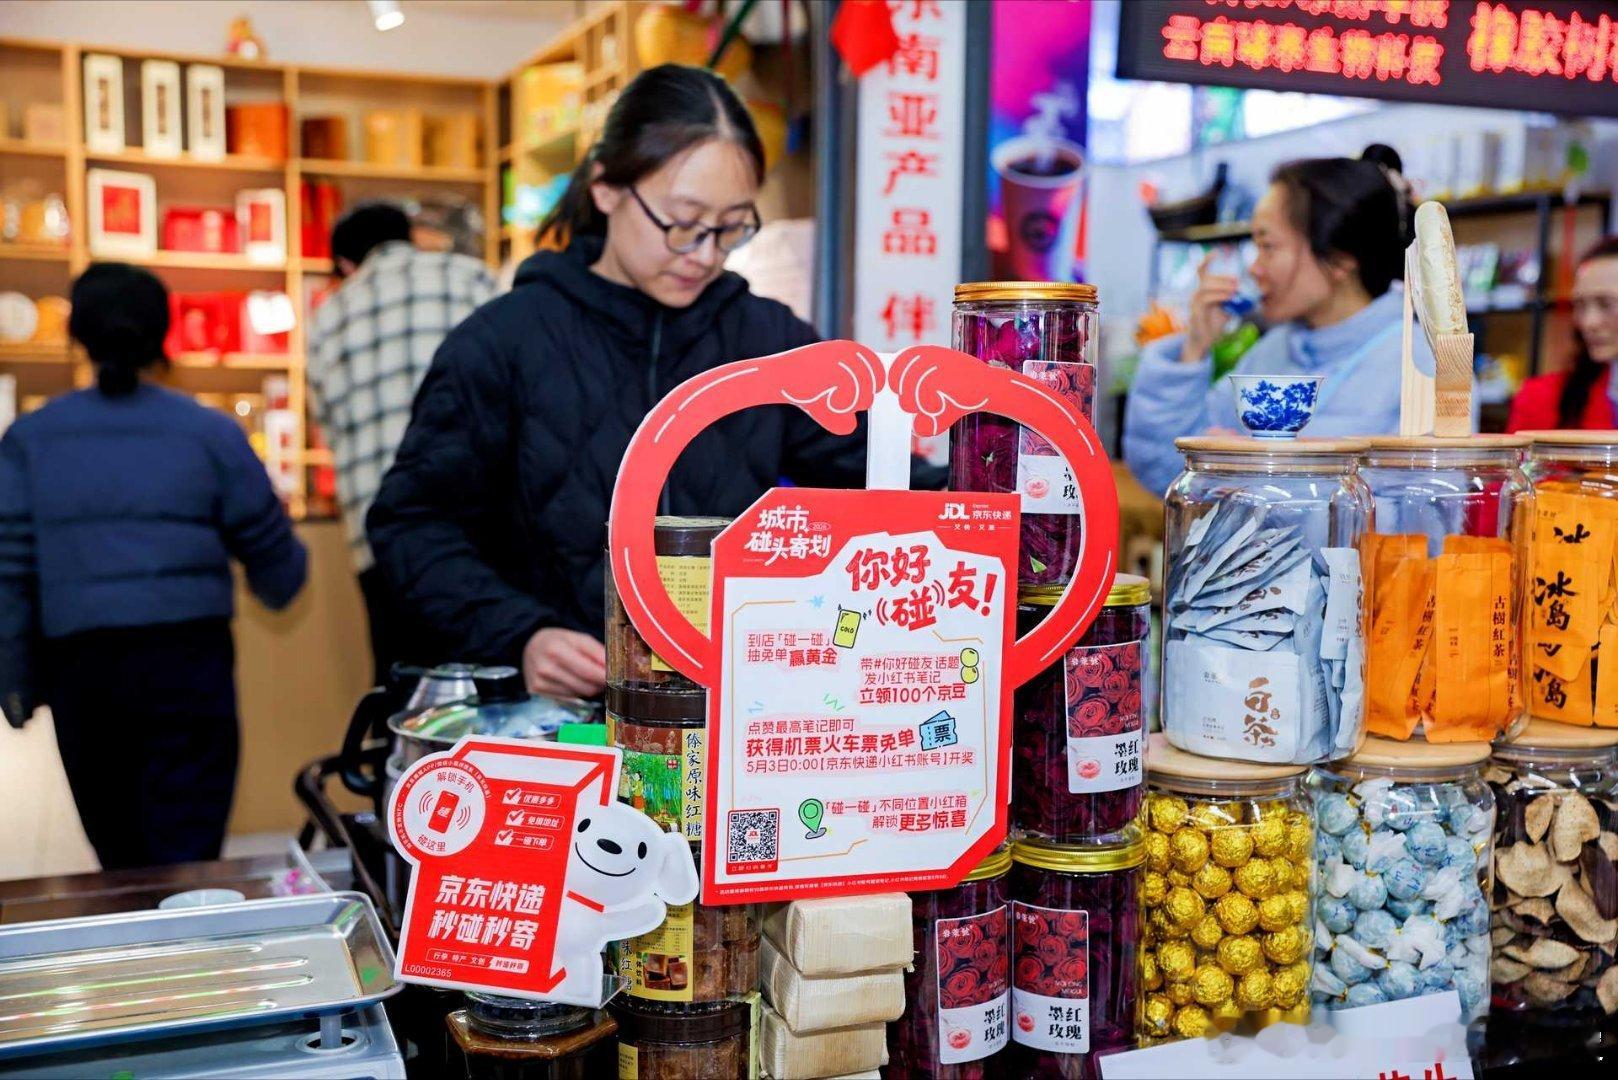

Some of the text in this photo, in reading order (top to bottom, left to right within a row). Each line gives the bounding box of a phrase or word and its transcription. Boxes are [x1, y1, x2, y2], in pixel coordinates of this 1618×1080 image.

[757, 505, 810, 533] 城市
[938, 502, 970, 520] JDL
[972, 510, 1012, 520] 京东快递
[744, 531, 831, 566] 碰头寄划
[848, 545, 930, 592] 你好
[864, 671, 941, 685] 发小红书笔记
[859, 683, 966, 704] 立领100个京豆
[747, 718, 855, 735] 点赞最高笔记即可
[934, 725, 950, 741] 票
[746, 729, 916, 757] 获得机票火车票免单
[1114, 757, 1139, 776] 玫瑰
[437, 771, 475, 793] 解锁手机
[685, 733, 702, 837] 傣家原味红糖
[872, 810, 967, 832] 解锁更多惊喜
[417, 834, 446, 852] 碰这里
[435, 873, 545, 915] 京东快递
[427, 909, 539, 951] 秒碰秒寄
[1048, 1005, 1082, 1022] 墨红
[984, 1019, 1005, 1041] 玫瑰
[1048, 1023, 1082, 1040] 玫瑰
